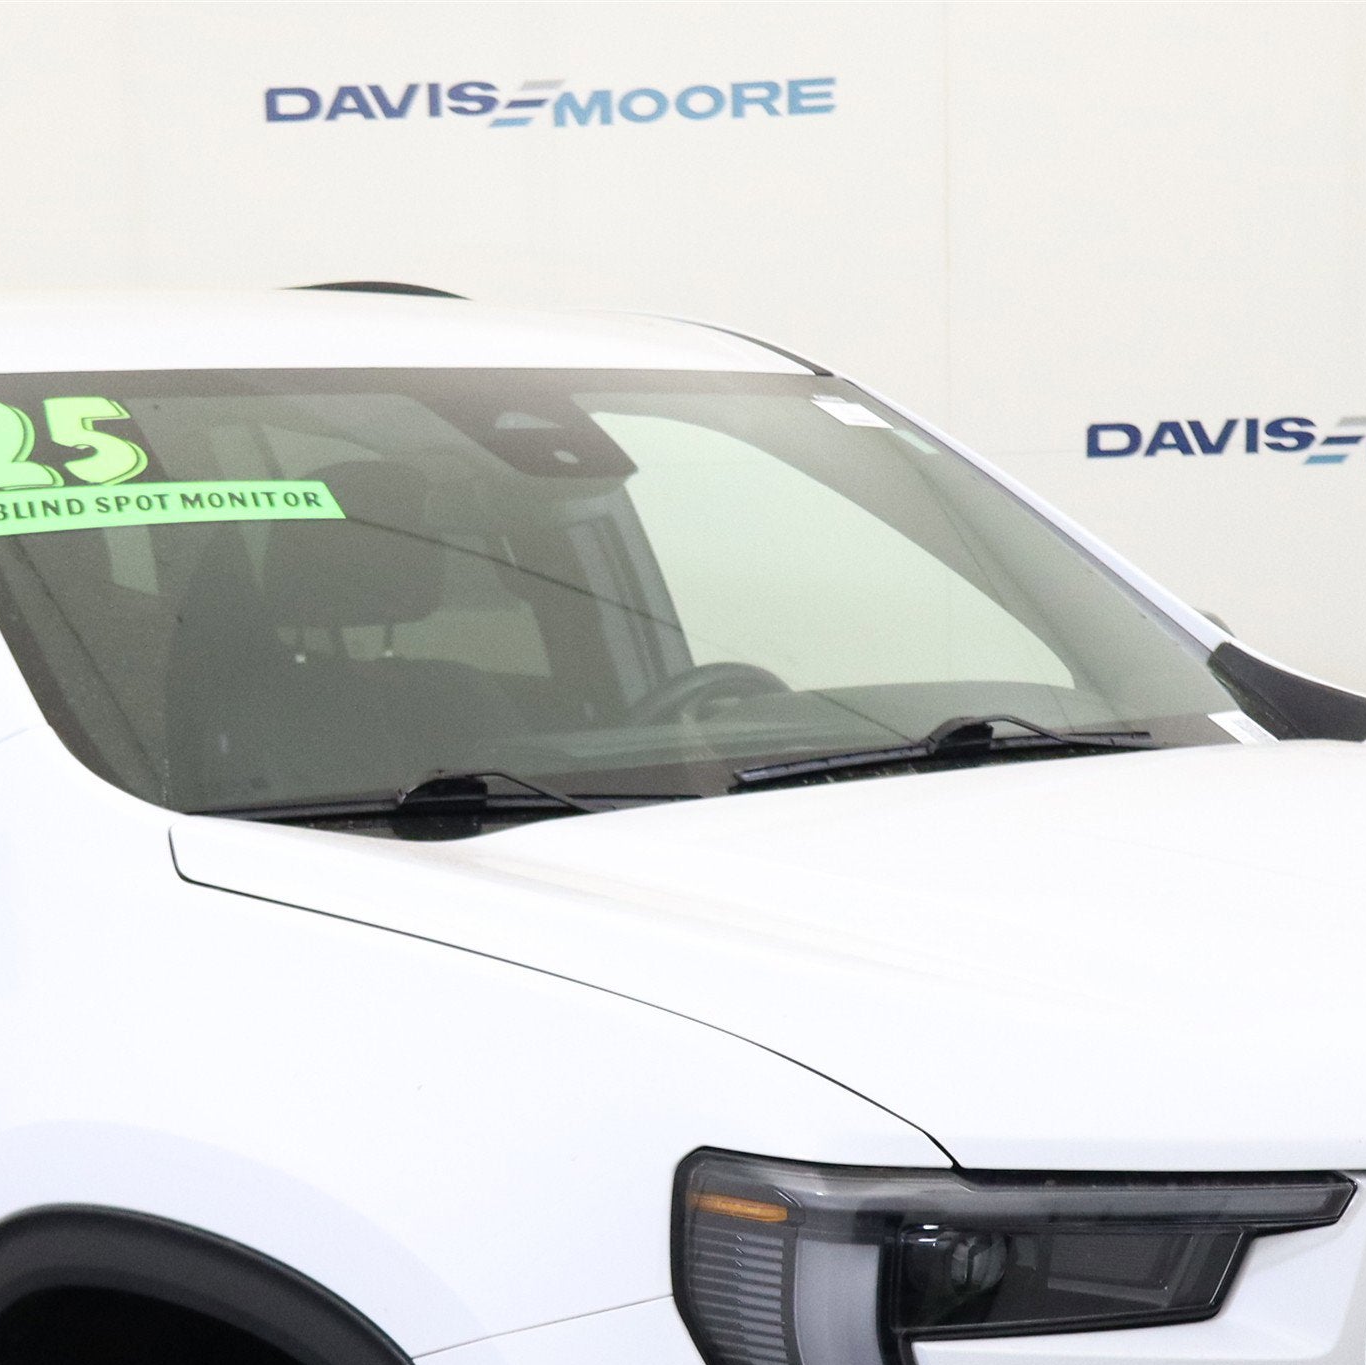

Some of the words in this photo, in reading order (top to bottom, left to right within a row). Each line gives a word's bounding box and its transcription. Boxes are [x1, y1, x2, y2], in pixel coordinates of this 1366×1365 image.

[264, 81, 499, 123] DAVIS
[552, 77, 837, 128] MOORE
[1086, 416, 1317, 459] DAVIS
[95, 493, 170, 514] SPOT
[179, 491, 322, 511] MONITOR
